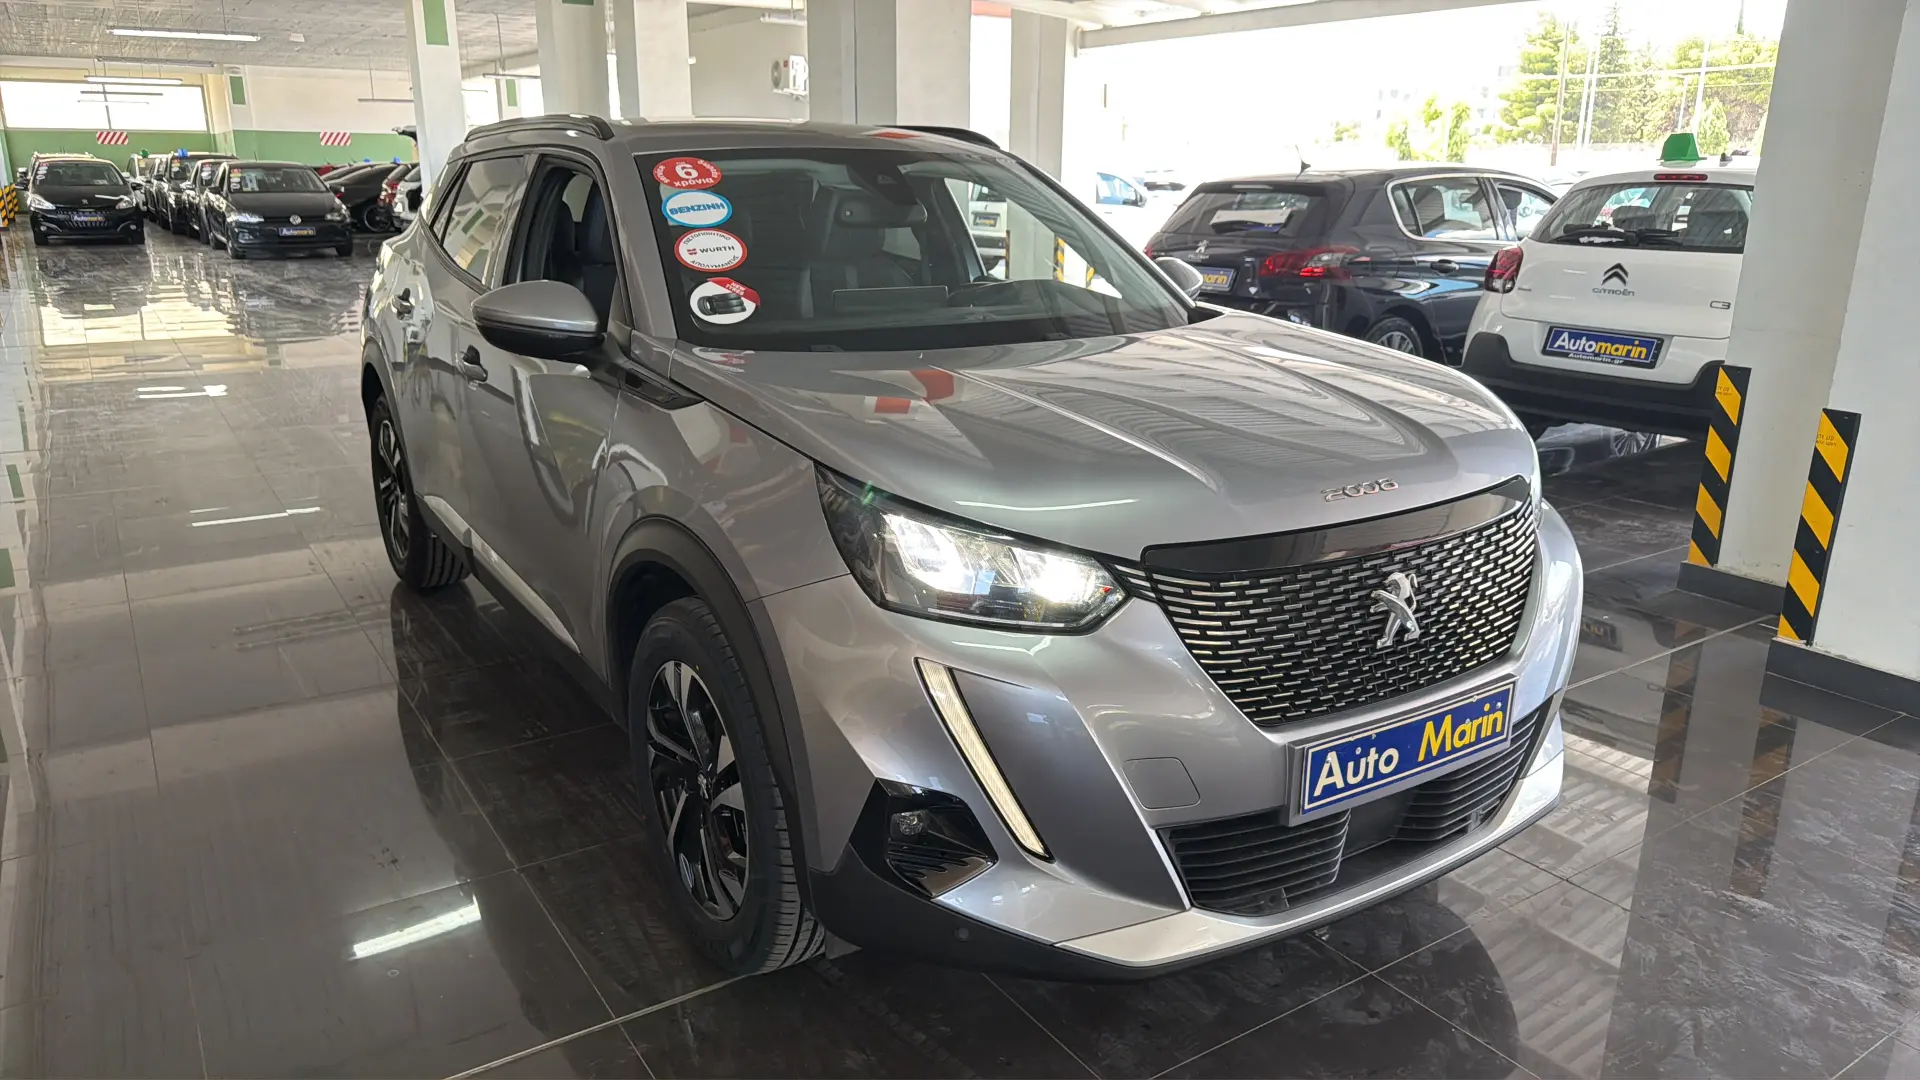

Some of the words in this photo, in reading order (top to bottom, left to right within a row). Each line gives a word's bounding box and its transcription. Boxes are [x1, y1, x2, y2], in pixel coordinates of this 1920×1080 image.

[675, 163, 699, 179] 6
[1709, 300, 1732, 310] C3
[1553, 331, 1647, 360] Automarin
[1567, 353, 1625, 364] Automarin.gr
[1313, 746, 1400, 797] Auto
[1416, 702, 1504, 763] Marin
